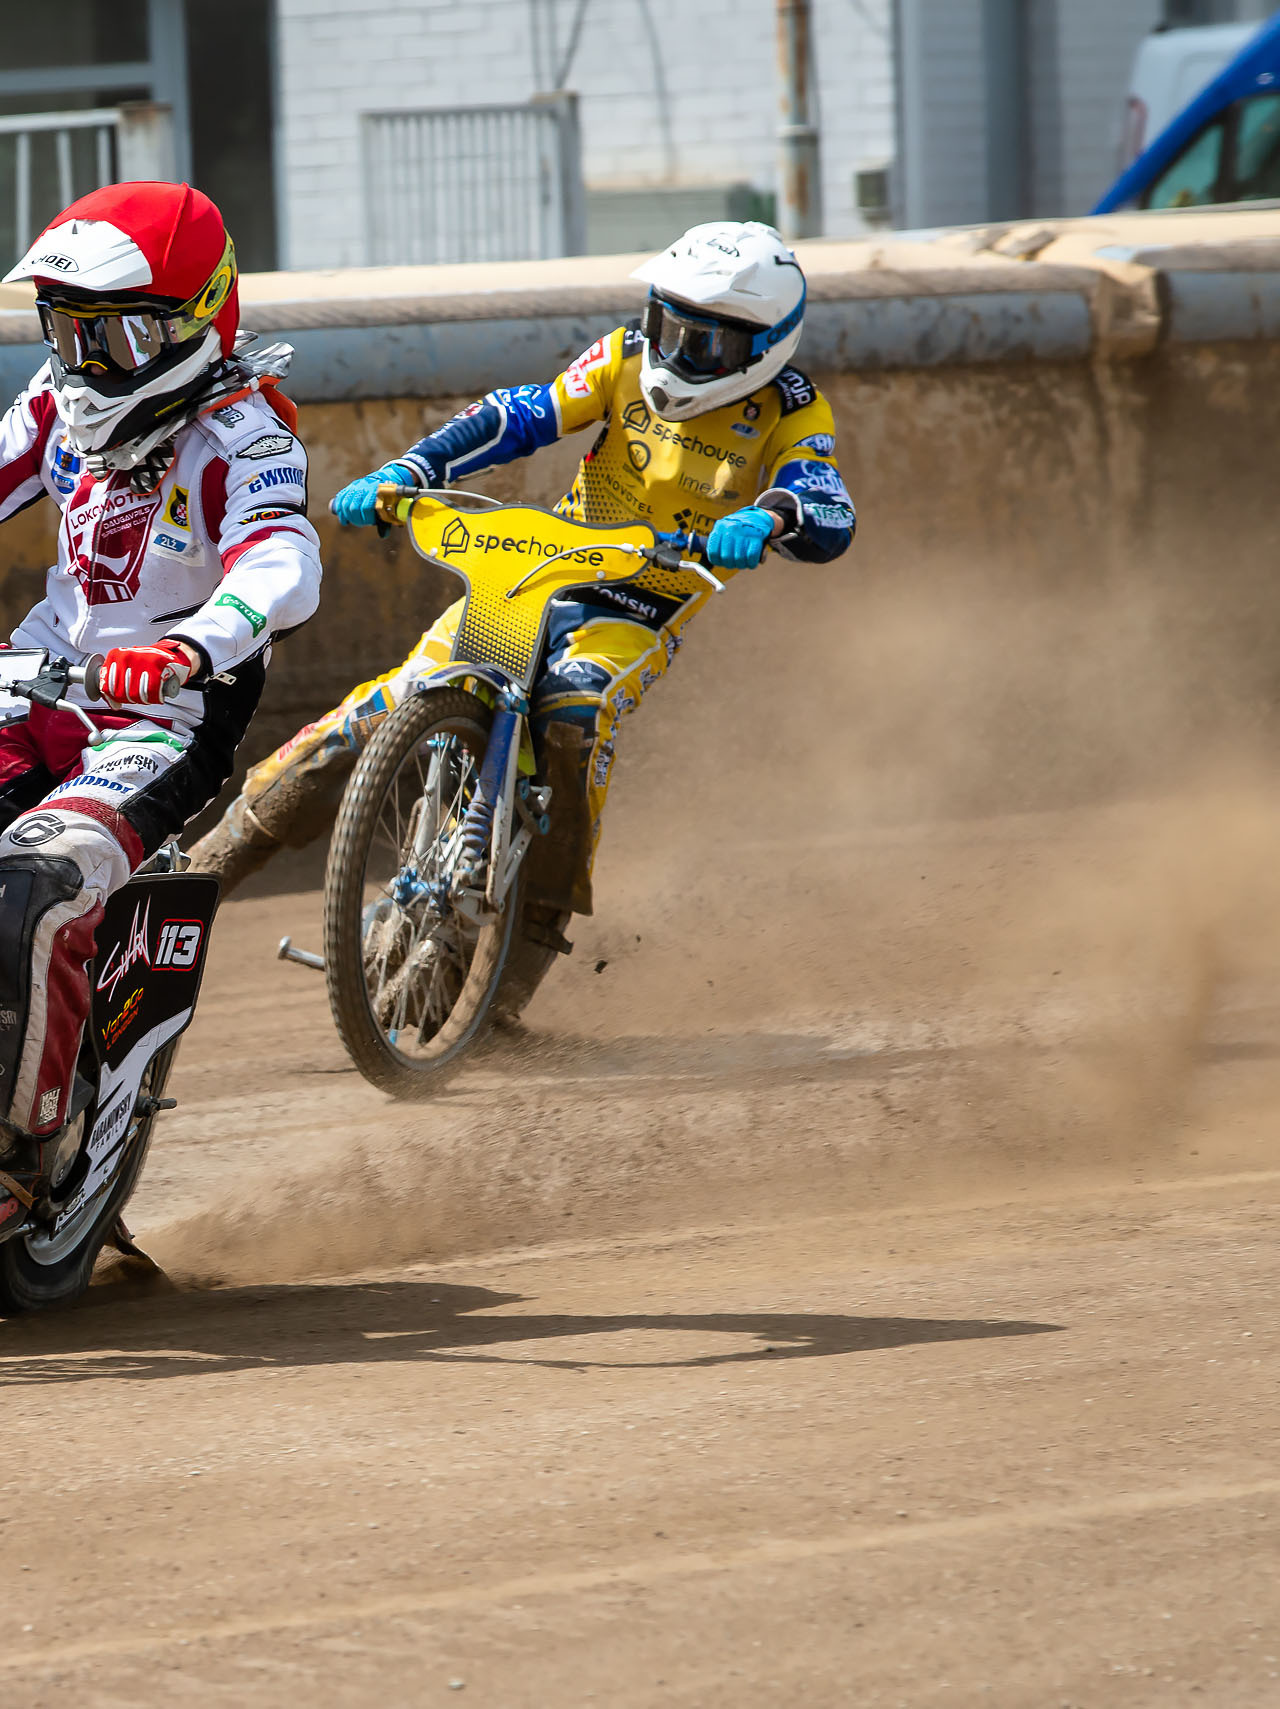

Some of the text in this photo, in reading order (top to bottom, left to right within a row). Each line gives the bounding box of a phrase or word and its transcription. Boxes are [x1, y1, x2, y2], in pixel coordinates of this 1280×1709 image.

[653, 423, 747, 468] spechouse
[605, 473, 654, 514] NOVOTEL
[103, 507, 151, 530] DAUGAVPILS
[133, 516, 147, 527] CLUB
[474, 532, 604, 567] spechouse
[155, 925, 201, 966] 113
